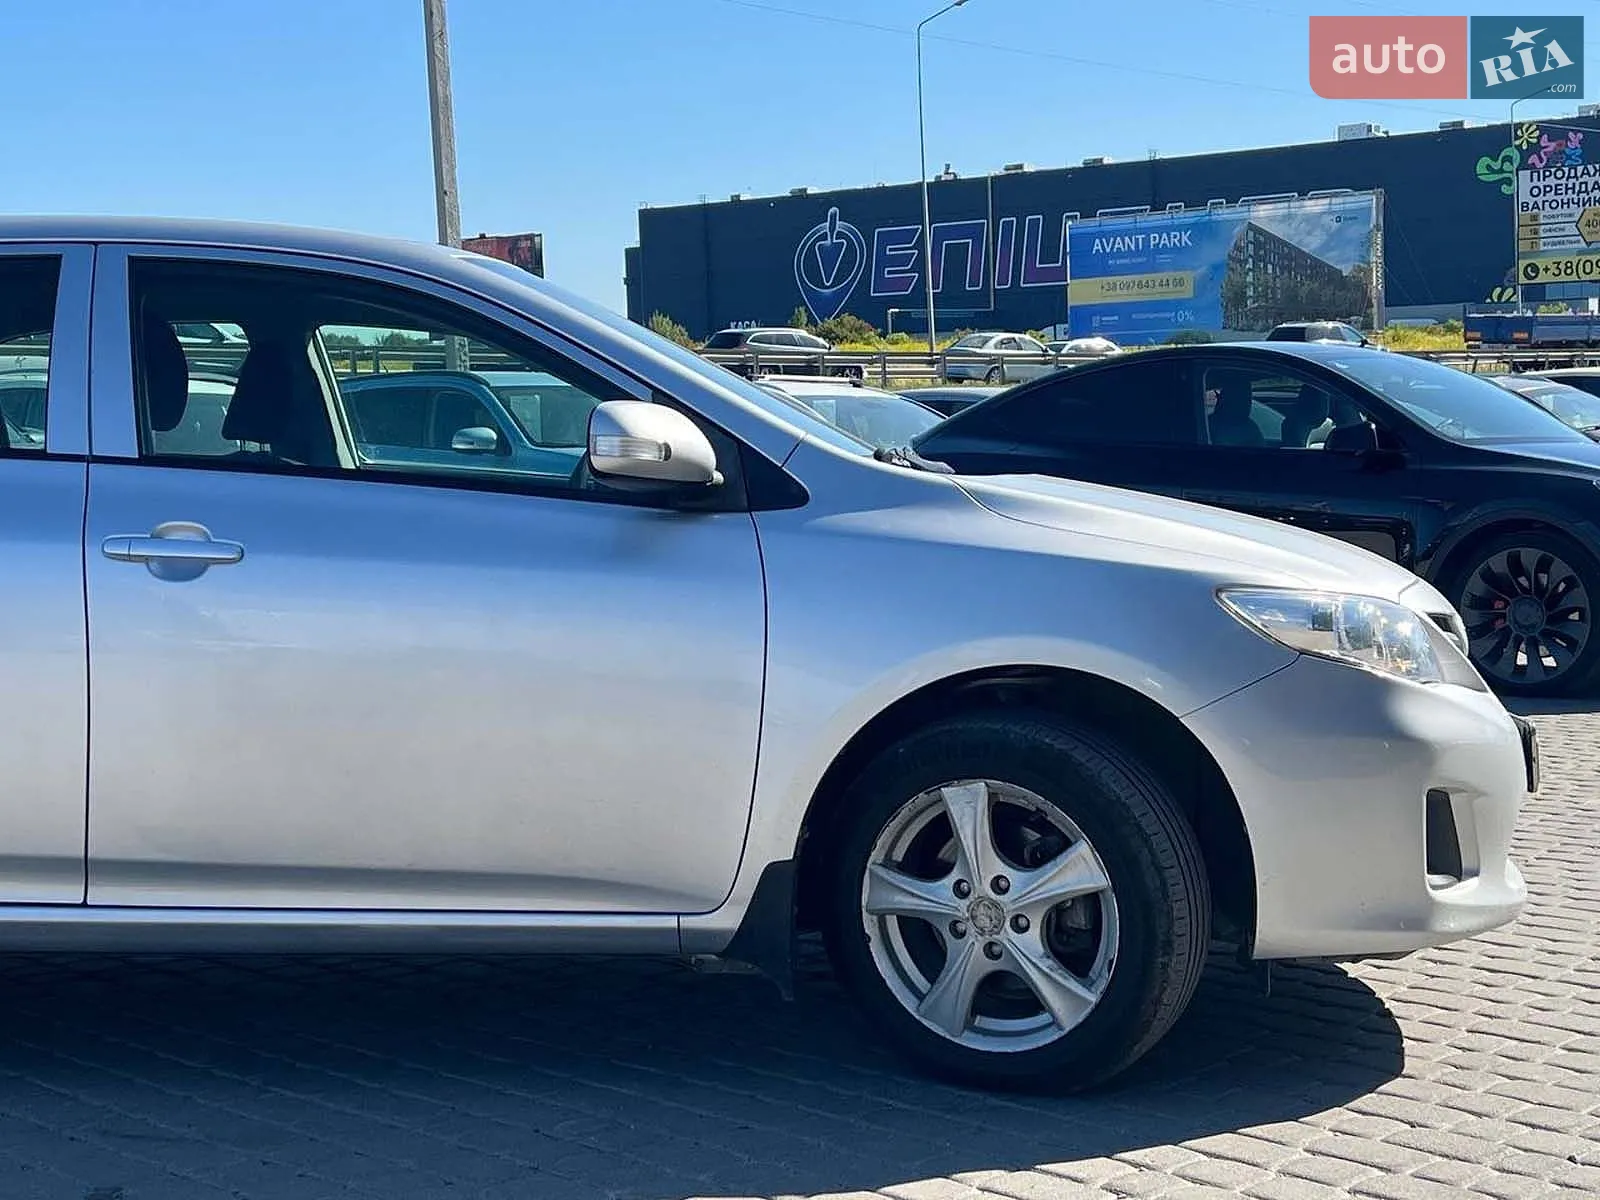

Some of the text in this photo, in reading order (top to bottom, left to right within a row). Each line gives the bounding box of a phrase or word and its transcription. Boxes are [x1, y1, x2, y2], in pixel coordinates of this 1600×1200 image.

[1529, 181, 1600, 198] ОРЕНДА
[1520, 196, 1600, 213] ВАГОНЧИК
[1092, 230, 1193, 254] AVANT PARK
